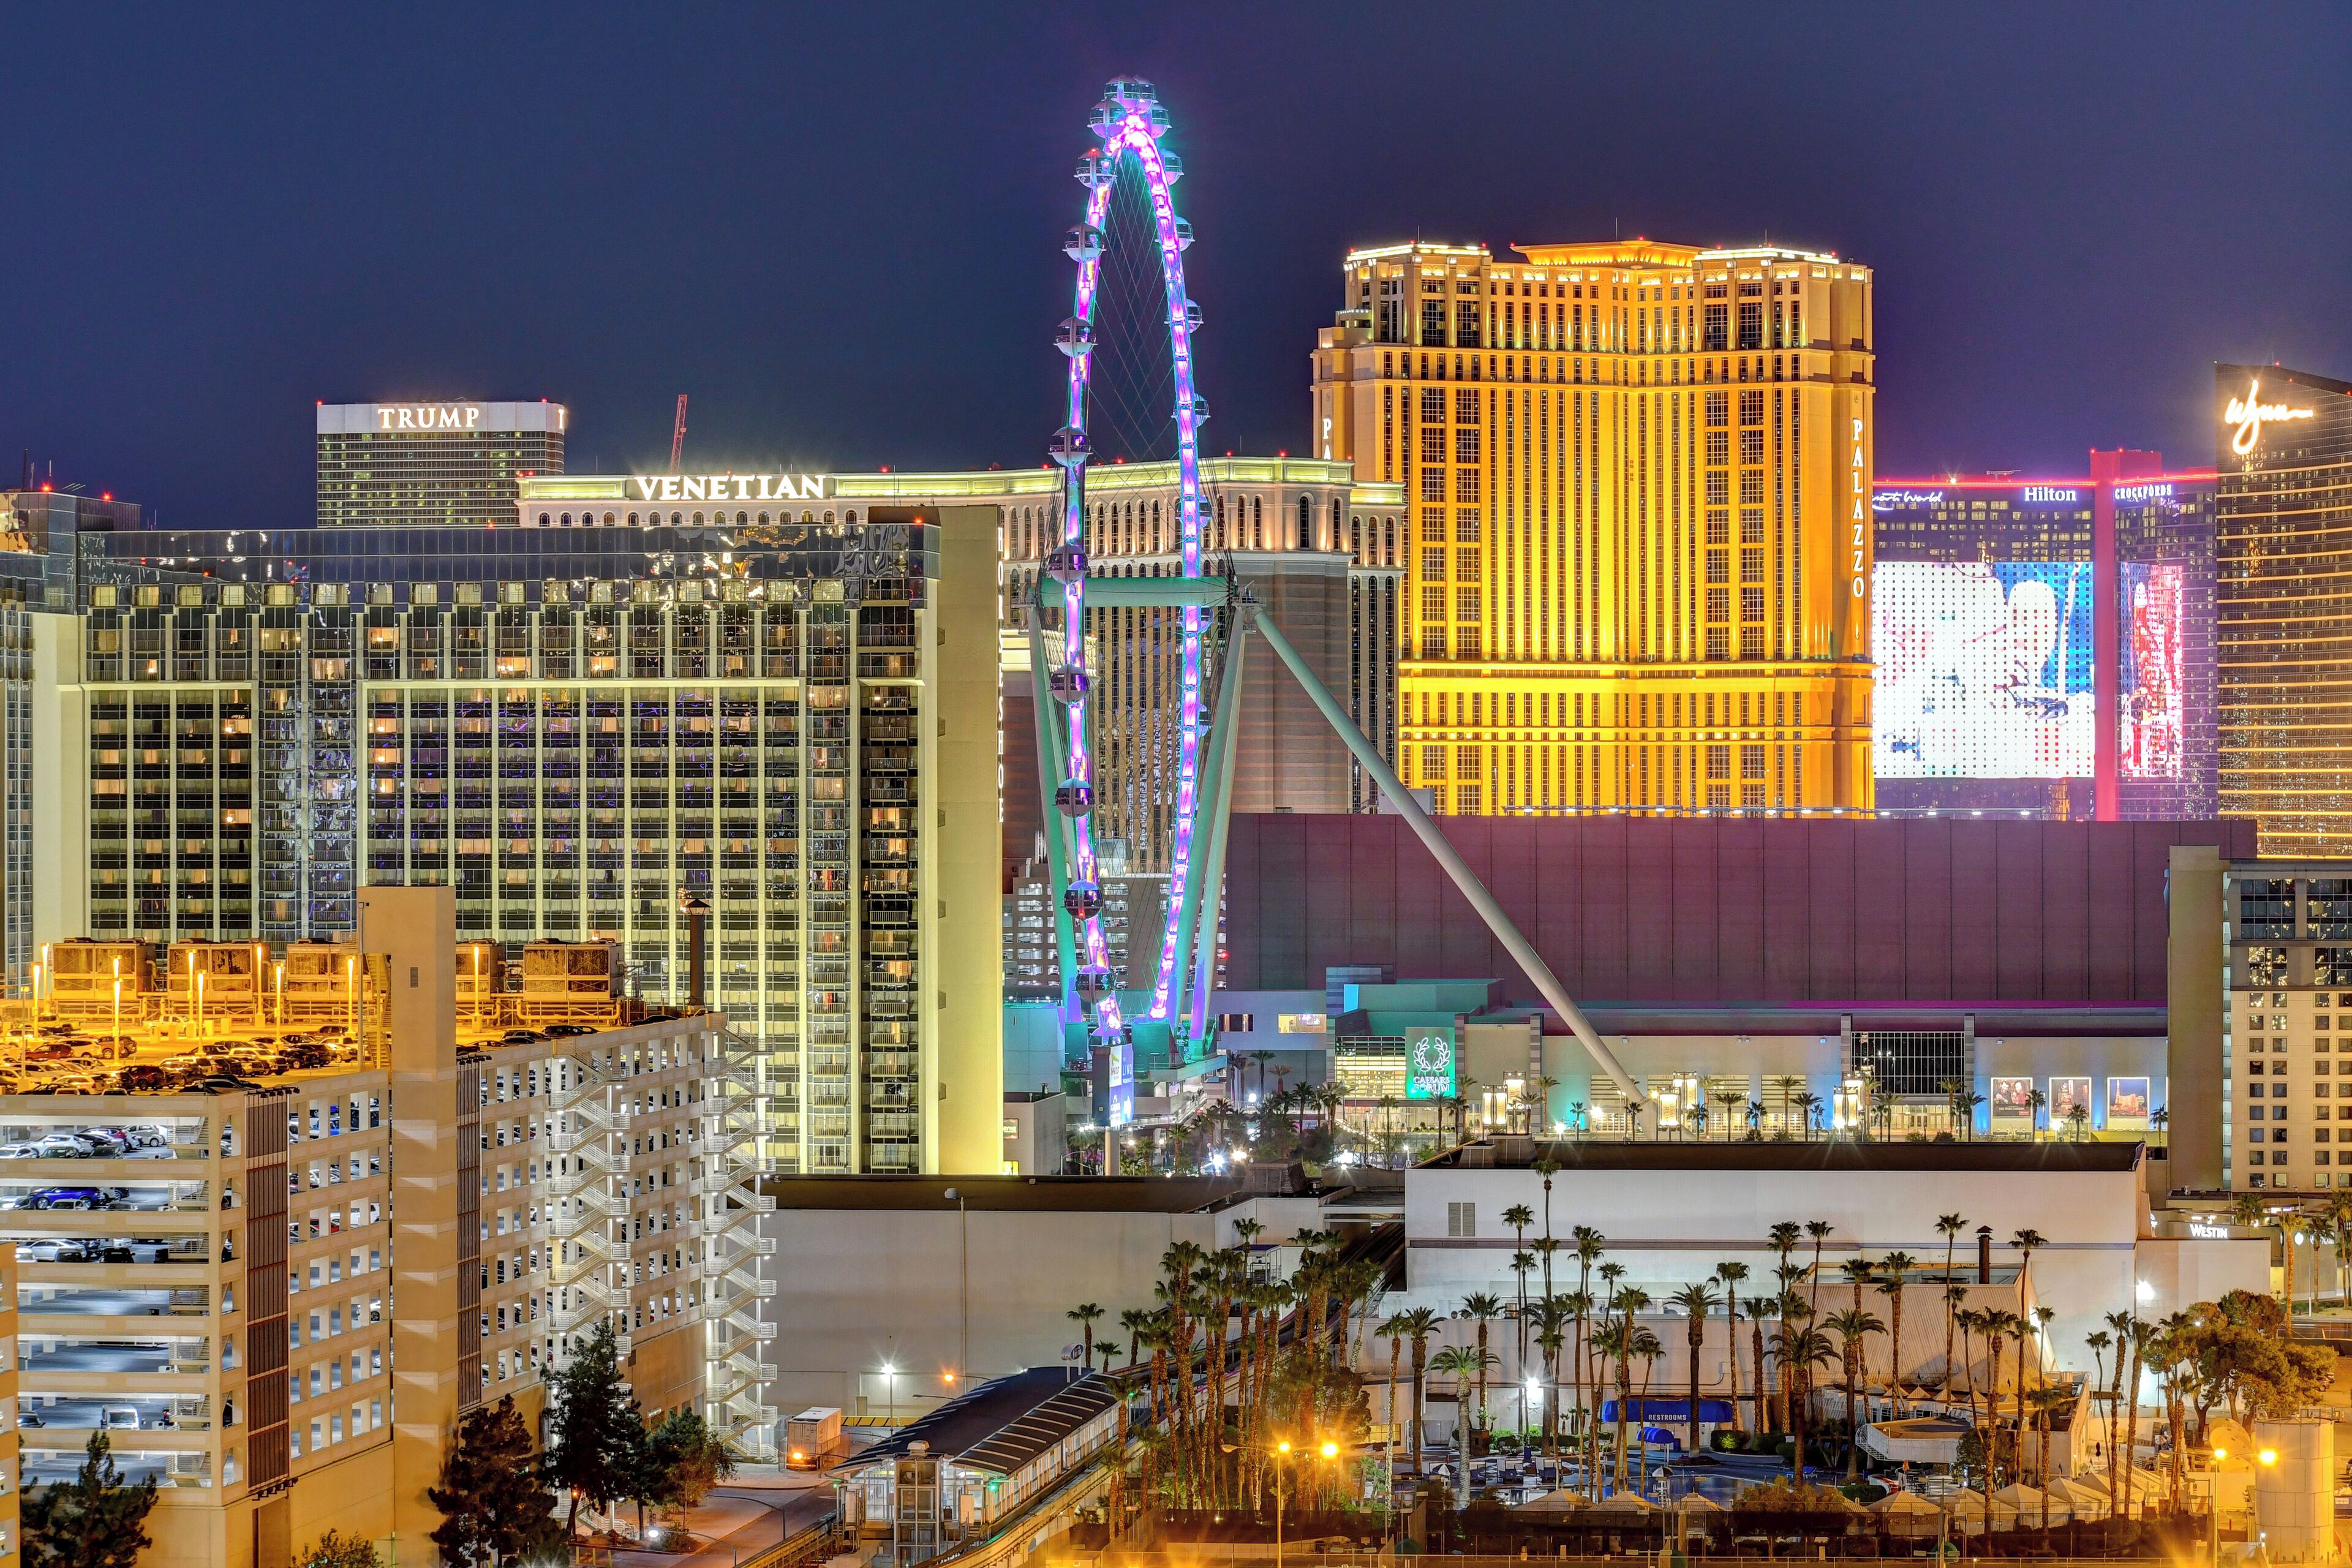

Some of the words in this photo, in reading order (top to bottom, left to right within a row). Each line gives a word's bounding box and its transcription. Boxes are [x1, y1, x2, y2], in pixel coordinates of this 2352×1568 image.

[377, 407, 480, 429] TRUMP
[634, 475, 826, 500] VENETIAN
[2024, 486, 2077, 501] Hilton
[2114, 484, 2172, 500] CROCKFORDS
[1904, 491, 1942, 502] World
[1852, 419, 1864, 598] PALAZZO
[1413, 1084, 1450, 1092] FORUM
[2190, 1224, 2228, 1239] WESTIN
